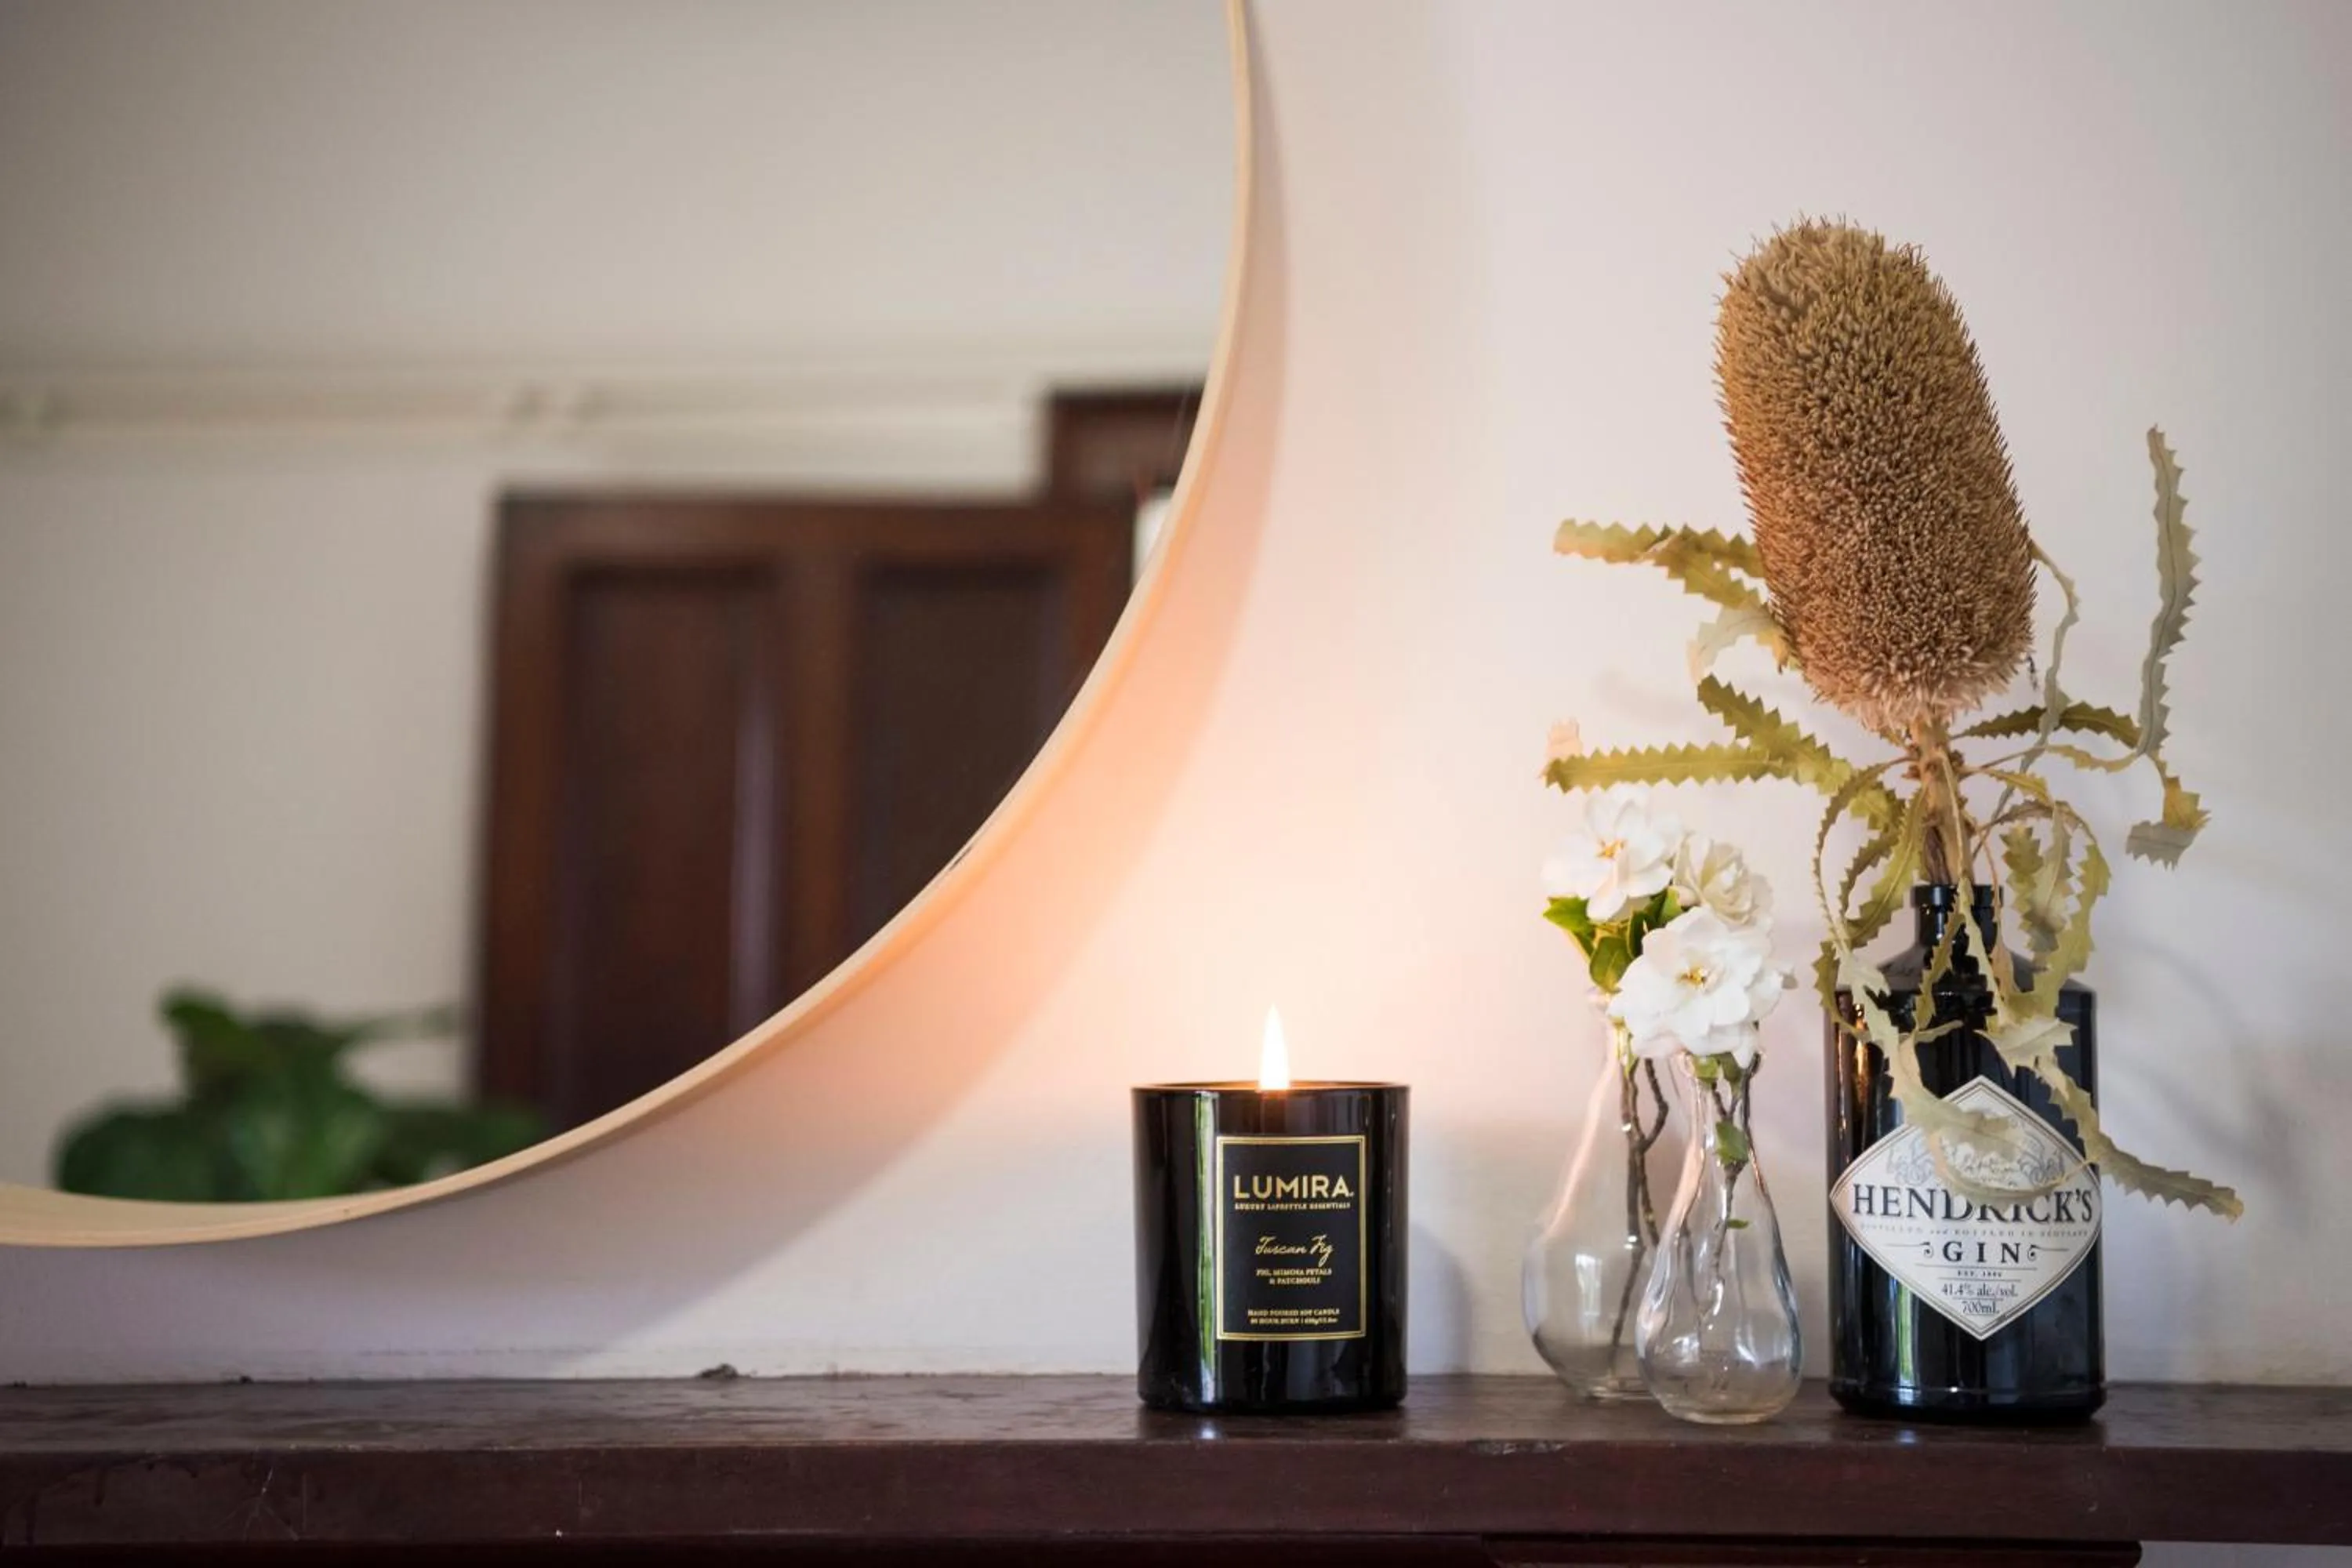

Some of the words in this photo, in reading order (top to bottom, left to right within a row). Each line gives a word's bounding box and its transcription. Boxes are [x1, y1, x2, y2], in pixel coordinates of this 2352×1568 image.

[1254, 1235, 1307, 1255] Tuscan
[1309, 1233, 1334, 1267] Fig
[1942, 1241, 2021, 1263] GIN
